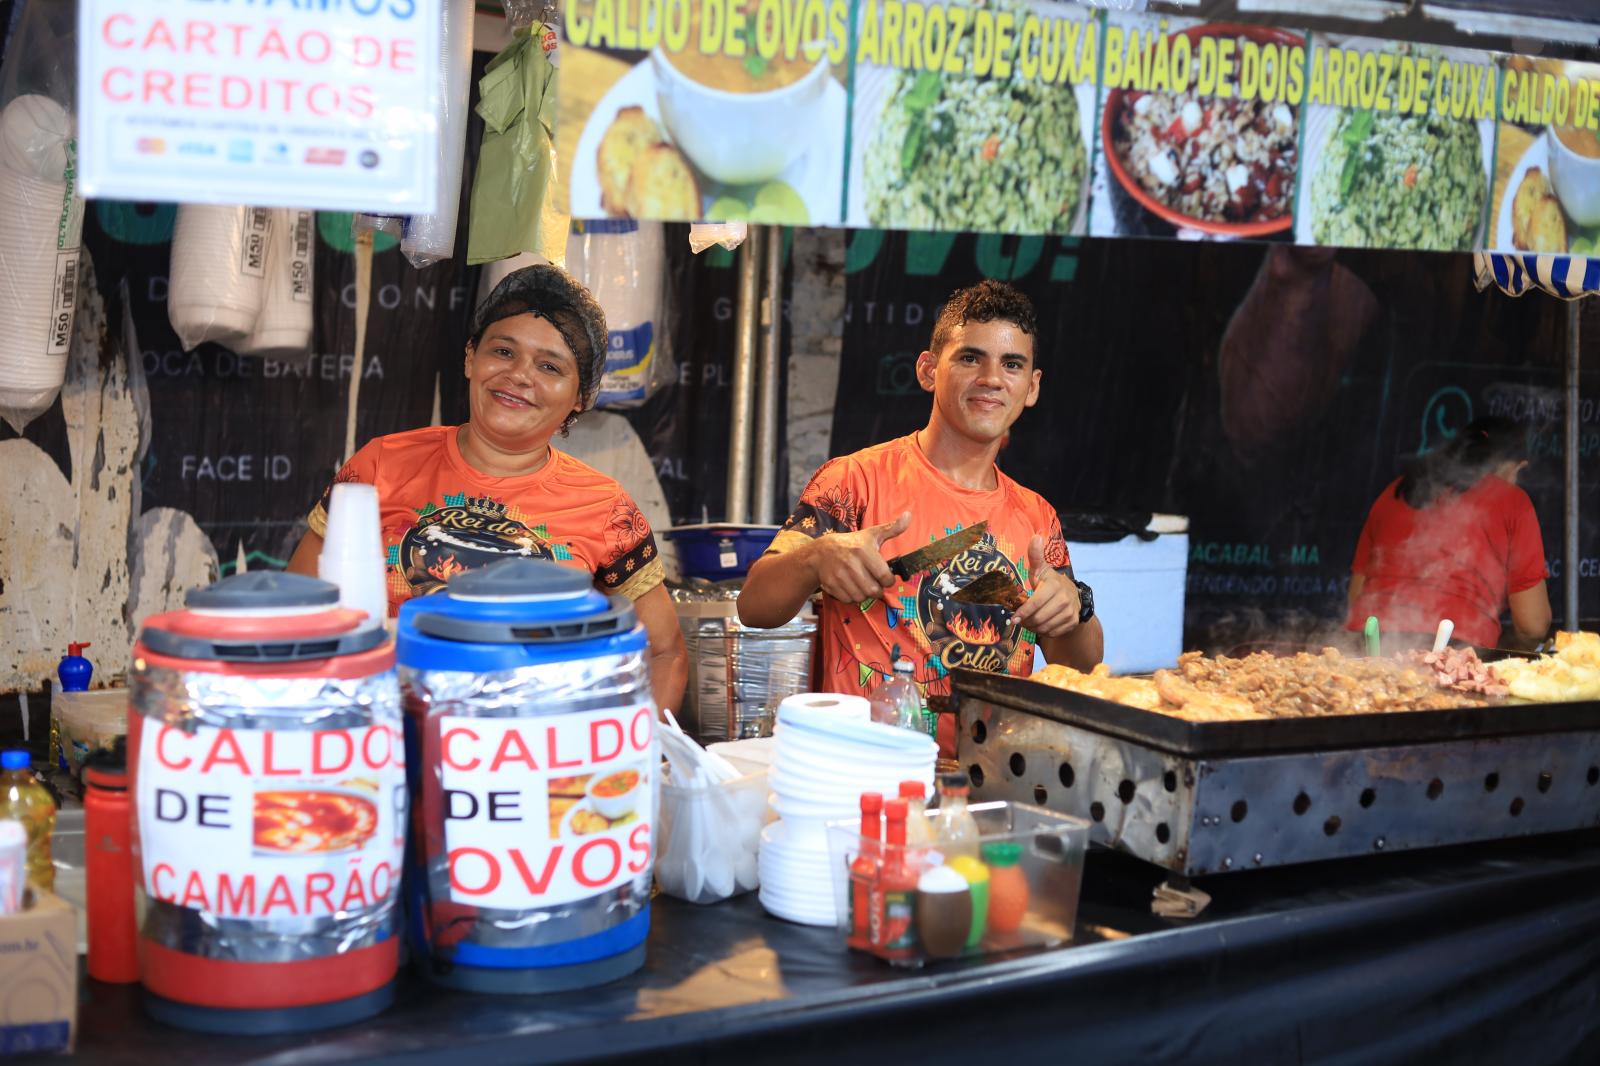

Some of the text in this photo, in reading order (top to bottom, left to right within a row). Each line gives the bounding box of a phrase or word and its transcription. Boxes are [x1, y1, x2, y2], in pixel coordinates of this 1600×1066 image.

[101, 12, 416, 72] CARTÃO DE
[565, 0, 847, 64] CALDO DE OVOS
[857, 0, 966, 73] ARROZ
[974, 10, 1014, 77] DE
[1103, 19, 1305, 105] BAIÃO DE DOIS
[1308, 47, 1393, 111] ARROZ
[1399, 56, 1430, 115] DE
[101, 66, 374, 119] CREDITOS
[1503, 68, 1600, 130] CALDO DE
[292, 260, 304, 294] M50
[56, 312, 69, 347] M50
[215, 352, 251, 378] DE
[263, 353, 385, 380] BATERA
[181, 454, 292, 481] FACE ID
[441, 508, 519, 536] Rei do
[949, 550, 1010, 575] Rei do
[1290, 544, 1321, 566] MA
[940, 640, 1002, 672] Caldo
[155, 723, 392, 777] CALDO
[441, 706, 652, 773] CALDO
[155, 788, 232, 829] DE
[446, 789, 523, 823] DE
[151, 856, 391, 917] CAMARÃO
[447, 823, 651, 897] OVOS
